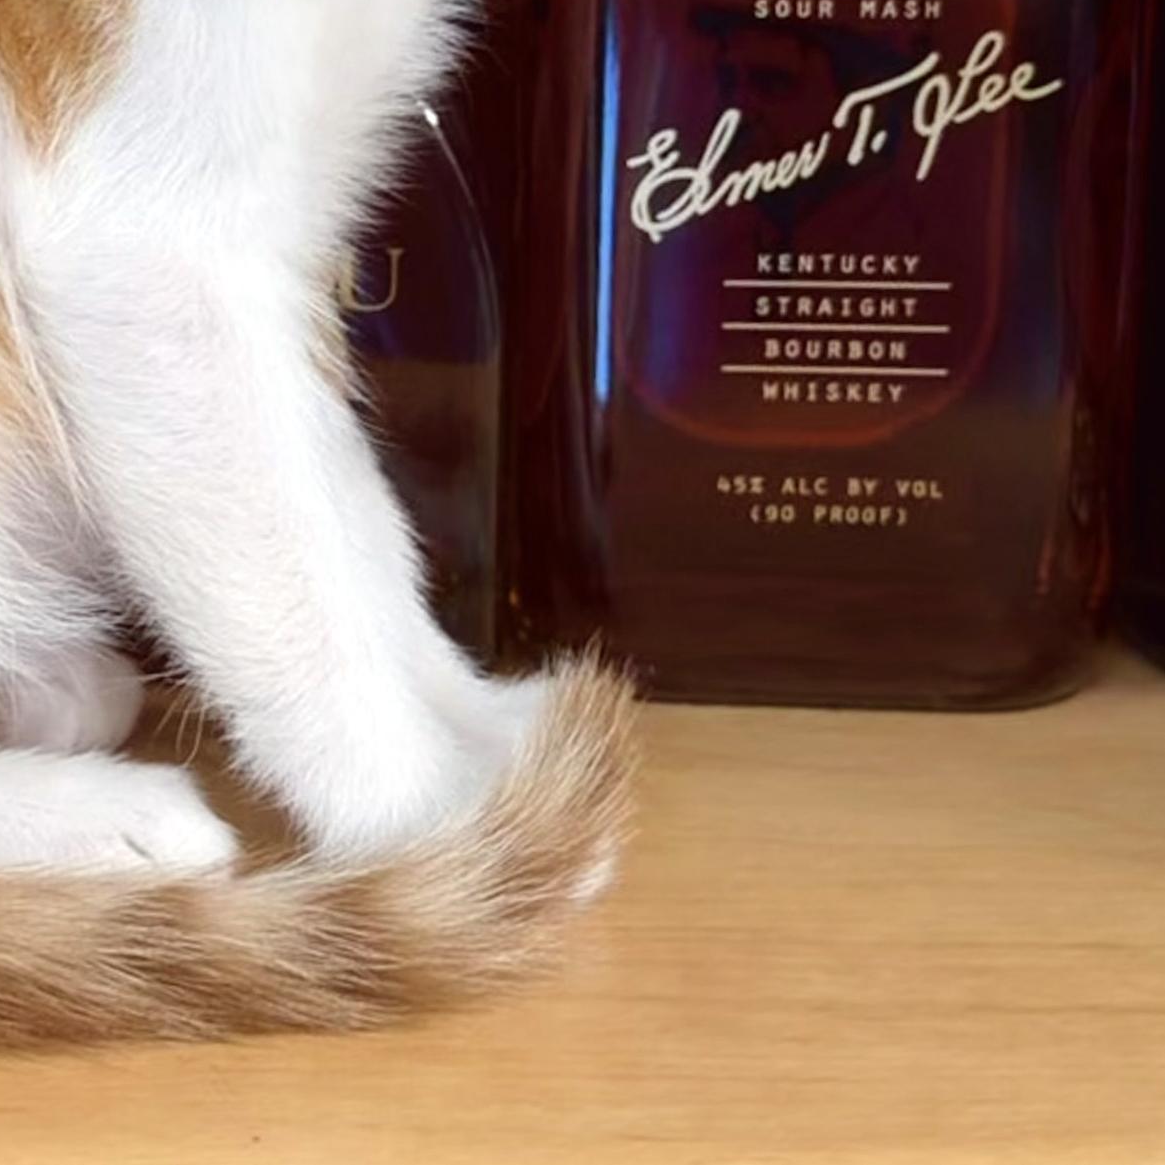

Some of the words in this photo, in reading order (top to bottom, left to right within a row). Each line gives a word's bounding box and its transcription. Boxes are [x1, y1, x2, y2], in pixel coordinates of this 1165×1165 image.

[754, 0, 835, 19] SOUR
[860, 0, 942, 19] MASH
[626, 109, 832, 244] Elmer
[833, 51, 940, 167] T.
[913, 31, 1064, 181] Lee
[757, 253, 921, 275] KENTUCKY
[755, 296, 918, 318] STRAIGHT
[764, 338, 907, 360] BOURBON
[761, 381, 904, 403] WHISKEY
[716, 476, 765, 495] 45%
[781, 477, 828, 496] ALC
[846, 477, 878, 497] BY
[895, 480, 943, 499] VOL
[750, 504, 796, 524] (90
[813, 506, 908, 525] PROOF)
